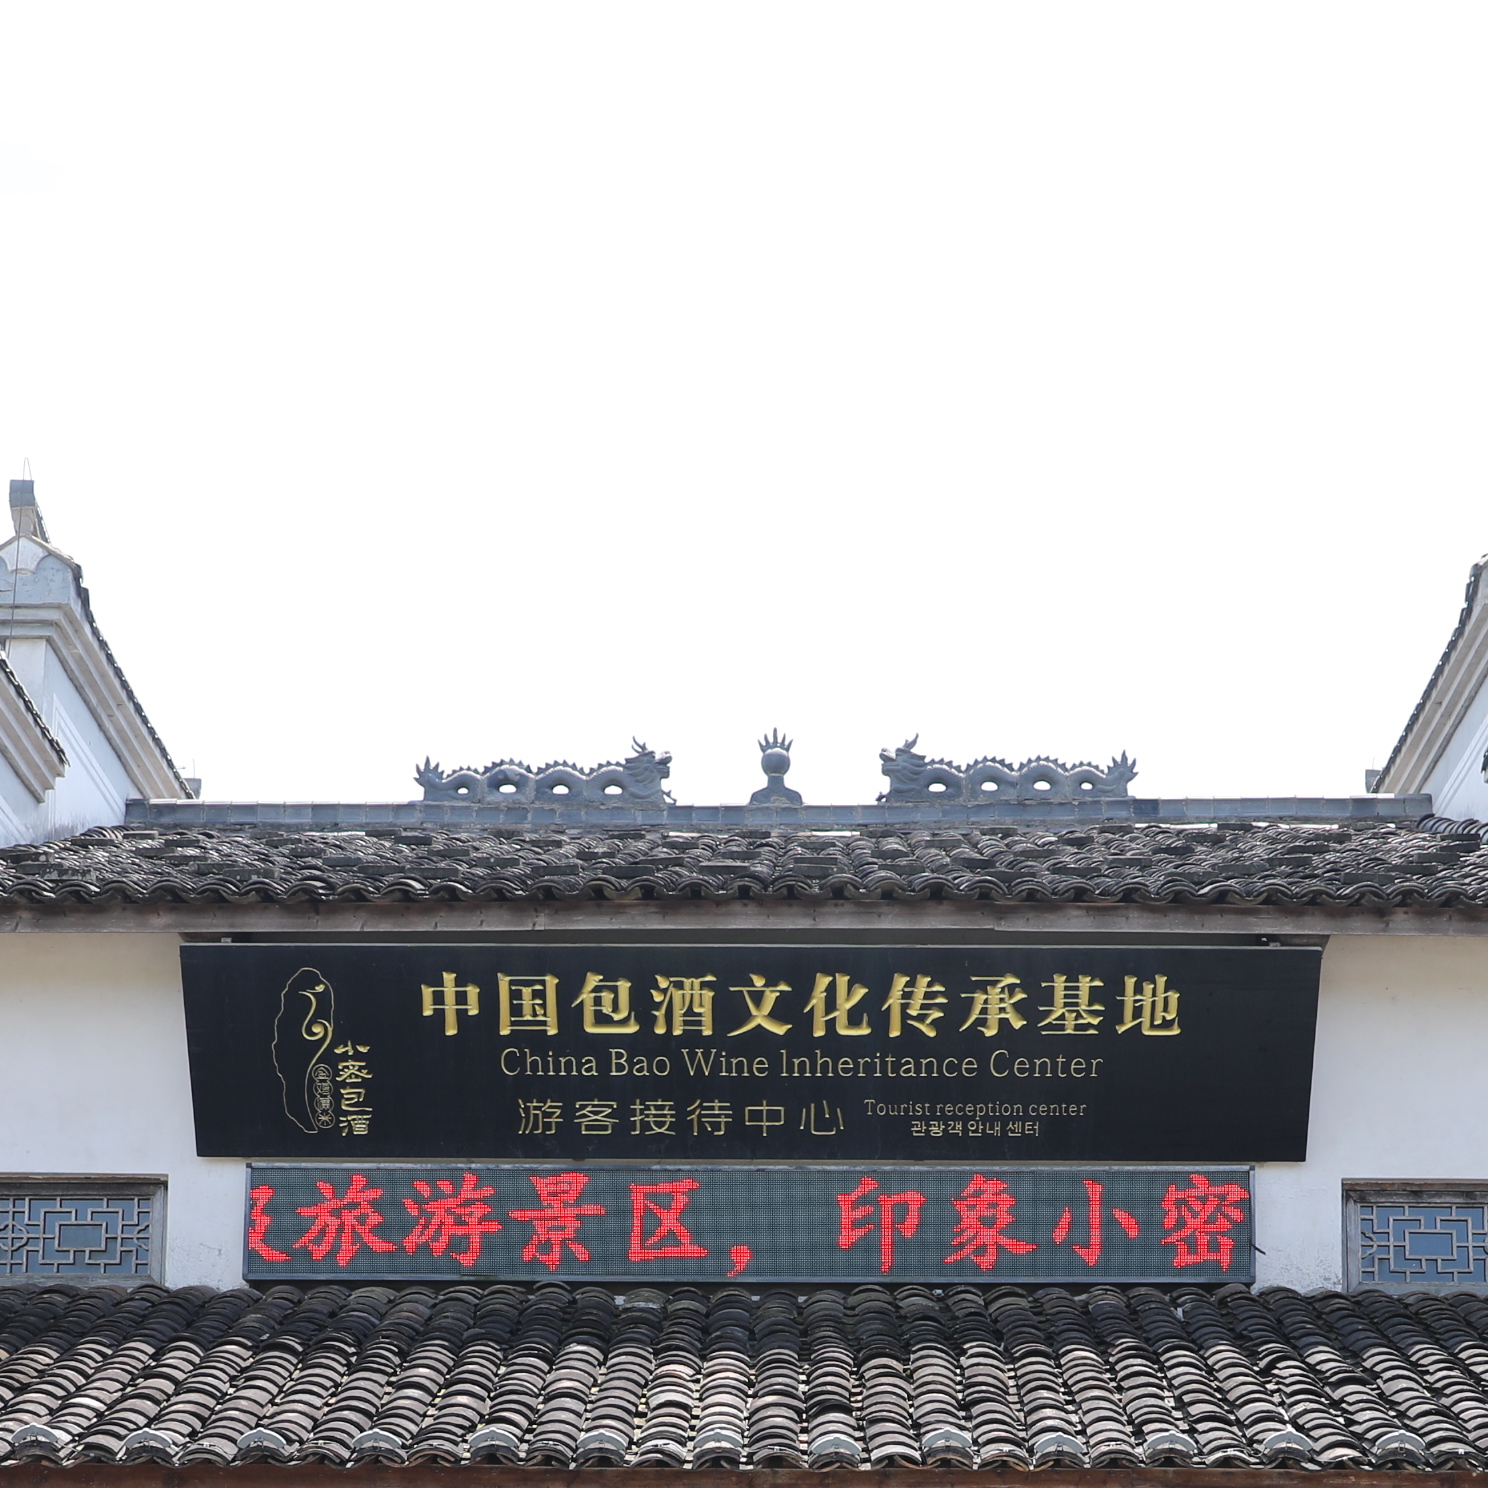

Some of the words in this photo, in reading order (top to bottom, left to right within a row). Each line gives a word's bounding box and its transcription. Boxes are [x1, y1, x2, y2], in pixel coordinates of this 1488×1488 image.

[420, 972, 1181, 1037] 中国包酒文化传承基地
[501, 1048, 599, 1076] China
[608, 1048, 670, 1076] Bao
[680, 1048, 769, 1077] Wine
[779, 1048, 978, 1077] Inheritance
[990, 1049, 1104, 1078] Center
[518, 1099, 844, 1137] 游客接待中心
[864, 1099, 930, 1116] Tourist
[936, 1101, 1022, 1122] reception
[1028, 1103, 1087, 1116] center
[910, 1120, 962, 1137] 관광객
[967, 1120, 1000, 1137] 안내
[1006, 1120, 1039, 1137] 센터
